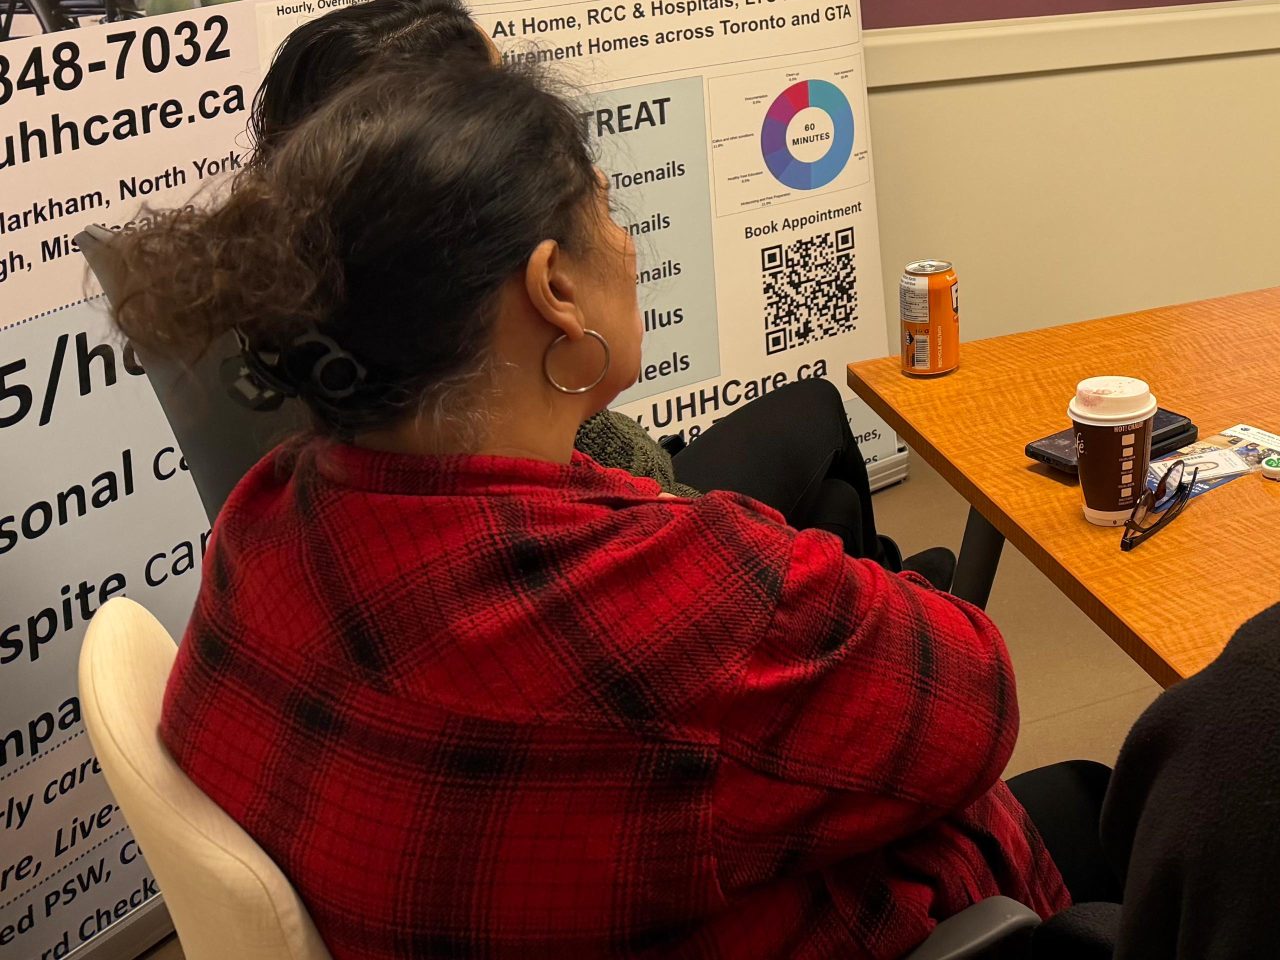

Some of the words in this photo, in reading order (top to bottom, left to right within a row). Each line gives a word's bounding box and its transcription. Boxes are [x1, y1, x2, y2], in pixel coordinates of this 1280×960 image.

[277, 1, 315, 17] Hourly,
[491, 20, 515, 38] At
[522, 15, 581, 35] Home,
[587, 4, 626, 25] RCC
[632, 3, 646, 19] &
[588, 34, 649, 55] Homes
[655, 25, 714, 45] across
[720, 16, 786, 36] Toronto
[792, 9, 820, 27] and
[824, 4, 852, 22] GTA
[580, 97, 671, 137] TREAT
[804, 123, 815, 132] 60
[792, 132, 830, 146] MINUTES
[612, 160, 686, 190] Toenails
[0, 190, 110, 236] arkham,
[119, 165, 186, 201] North
[744, 221, 779, 239] Book
[782, 200, 862, 233] Appointment
[45, 857, 111, 918] PSW,
